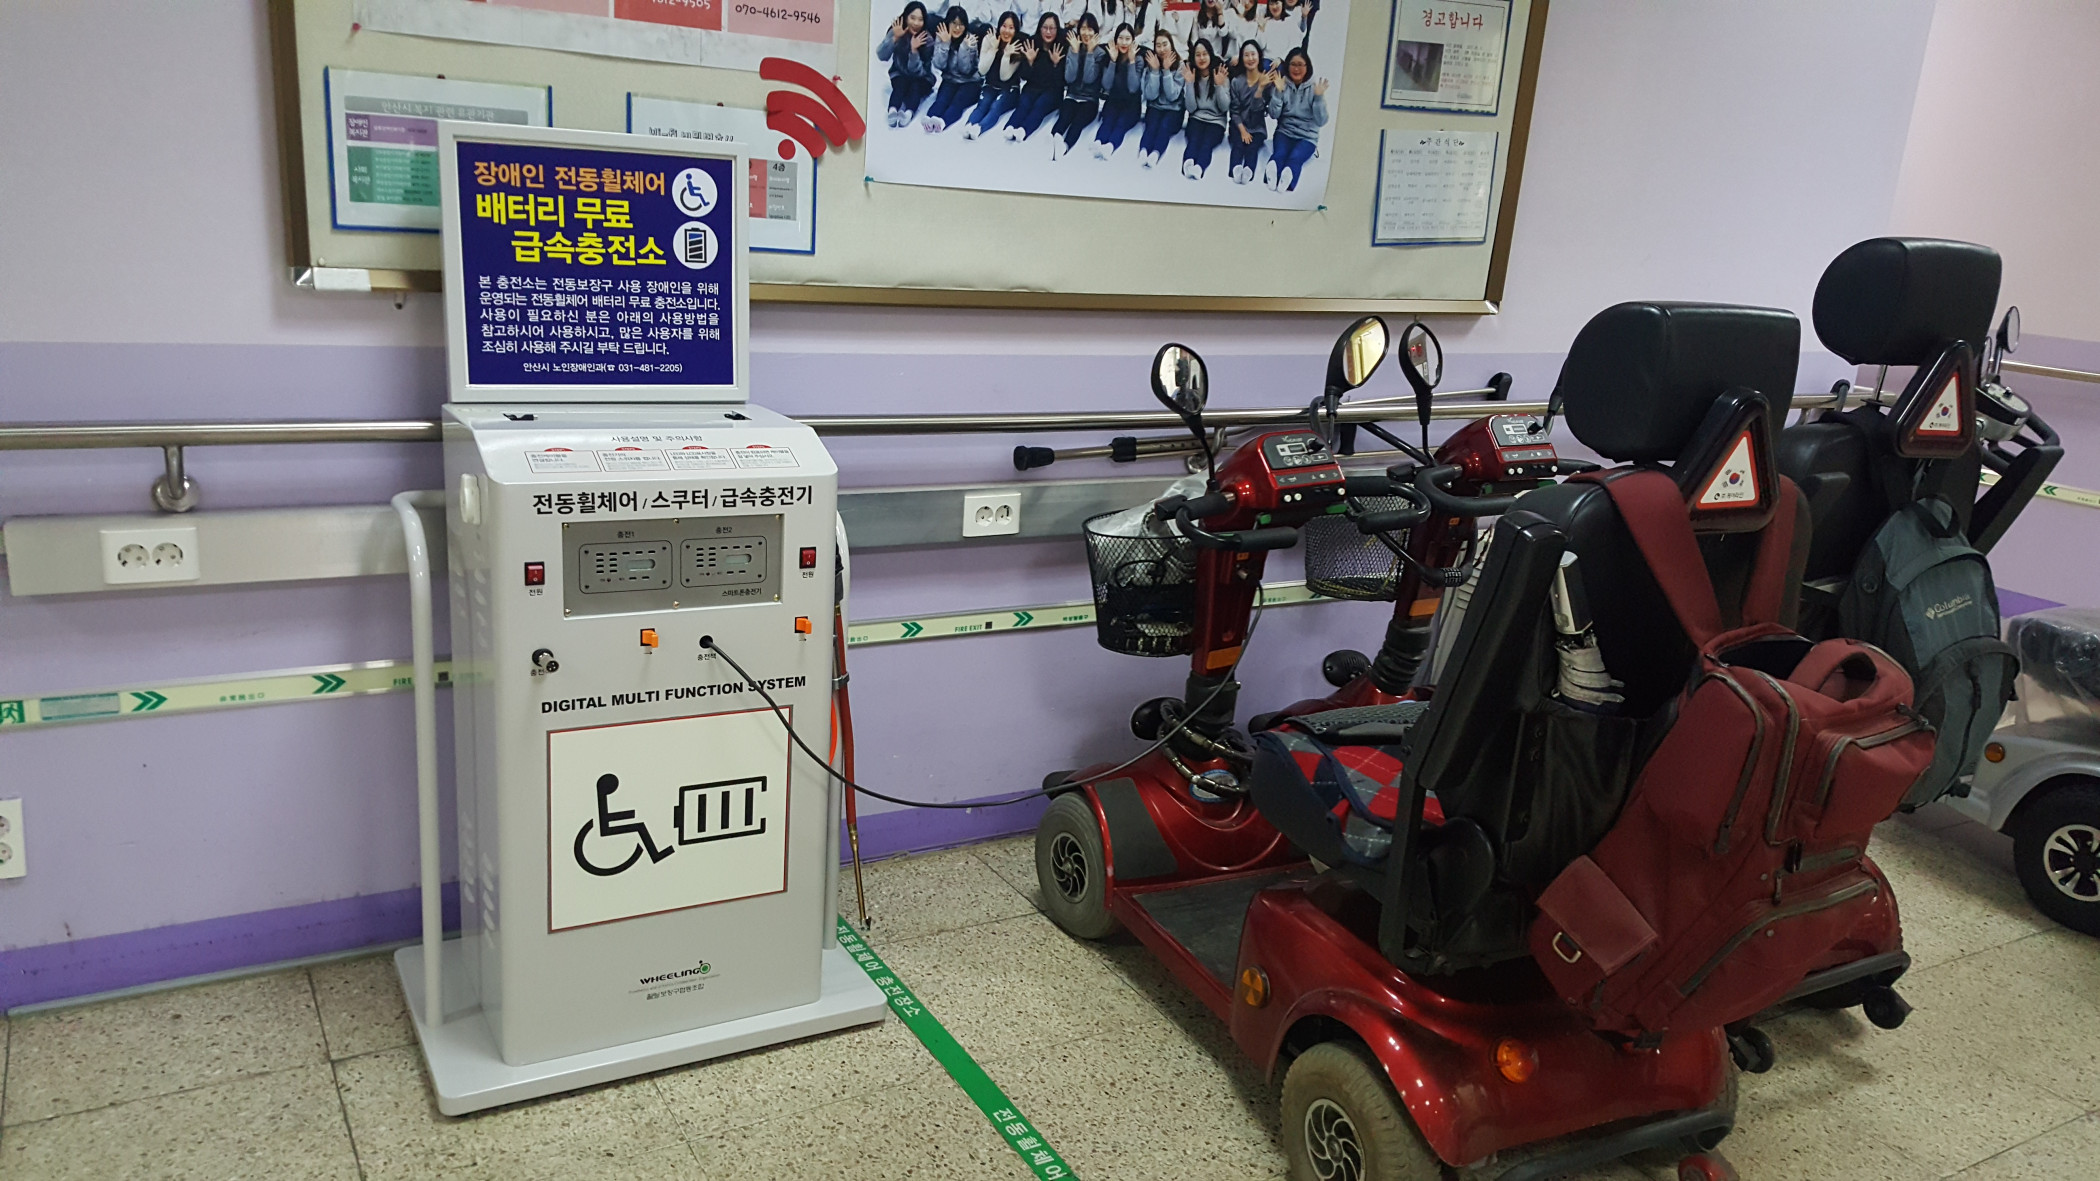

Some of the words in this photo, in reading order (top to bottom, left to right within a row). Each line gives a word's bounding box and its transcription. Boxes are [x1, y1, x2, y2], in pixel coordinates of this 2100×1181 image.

[735, 4, 821, 24] 070-4612-9546
[1421, 9, 1484, 30] 경고합니다
[473, 161, 544, 189] 장애인
[555, 166, 666, 196] 전동휠체어
[476, 192, 565, 228] 배터리
[574, 197, 634, 229] 무료
[511, 230, 667, 266] 급속충전소
[478, 275, 491, 286] 본
[497, 276, 547, 290] 충전소는
[552, 278, 613, 292] 전동보장구
[618, 279, 641, 293] 사용
[647, 280, 692, 294] 장애인을
[697, 282, 719, 295] 위해
[479, 292, 527, 306] 운영되는
[531, 293, 588, 307] 전동휠체어
[592, 295, 625, 308] 배터리
[629, 296, 651, 308] 무료
[654, 297, 721, 311] 충전소입니다.
[480, 309, 520, 322] 사용이
[527, 309, 579, 323] 필요하신
[586, 310, 610, 323] 분은
[616, 311, 653, 324] 아래의
[659, 312, 720, 325] 사용방법을
[481, 324, 544, 338] 참고하시어
[549, 325, 614, 340] 사용하시고,
[619, 326, 643, 340] 많은
[648, 327, 693, 340] 사용자를
[698, 328, 720, 340] 위해
[482, 342, 518, 354] 조심히
[522, 342, 556, 355] 사용해
[559, 342, 594, 355] 주시길
[597, 342, 619, 355] 부탁
[623, 343, 669, 355] 드립니다.
[523, 362, 550, 373] 안산시
[619, 364, 683, 373] 031-481-2205)
[611, 434, 650, 443] 사용설명
[653, 434, 662, 443] 및
[665, 434, 703, 443] 주의사항
[532, 491, 640, 516] 전동휠체어
[650, 491, 710, 511] 스쿠터
[719, 484, 814, 507] 급속충전기
[802, 570, 814, 579] 전원
[528, 588, 544, 597] 전원
[1934, 594, 1970, 613] Columbia
[954, 625, 968, 633] FIRE
[969, 624, 982, 632] EXIT
[393, 677, 412, 686] FIRE
[541, 697, 607, 714] DIGITAL
[611, 690, 660, 707] MULTI
[664, 681, 743, 703] FUNCTION
[747, 675, 806, 693] SYSTEM
[875, 975, 921, 1018] 충전장소
[992, 1107, 1067, 1181] 전동휠체어
